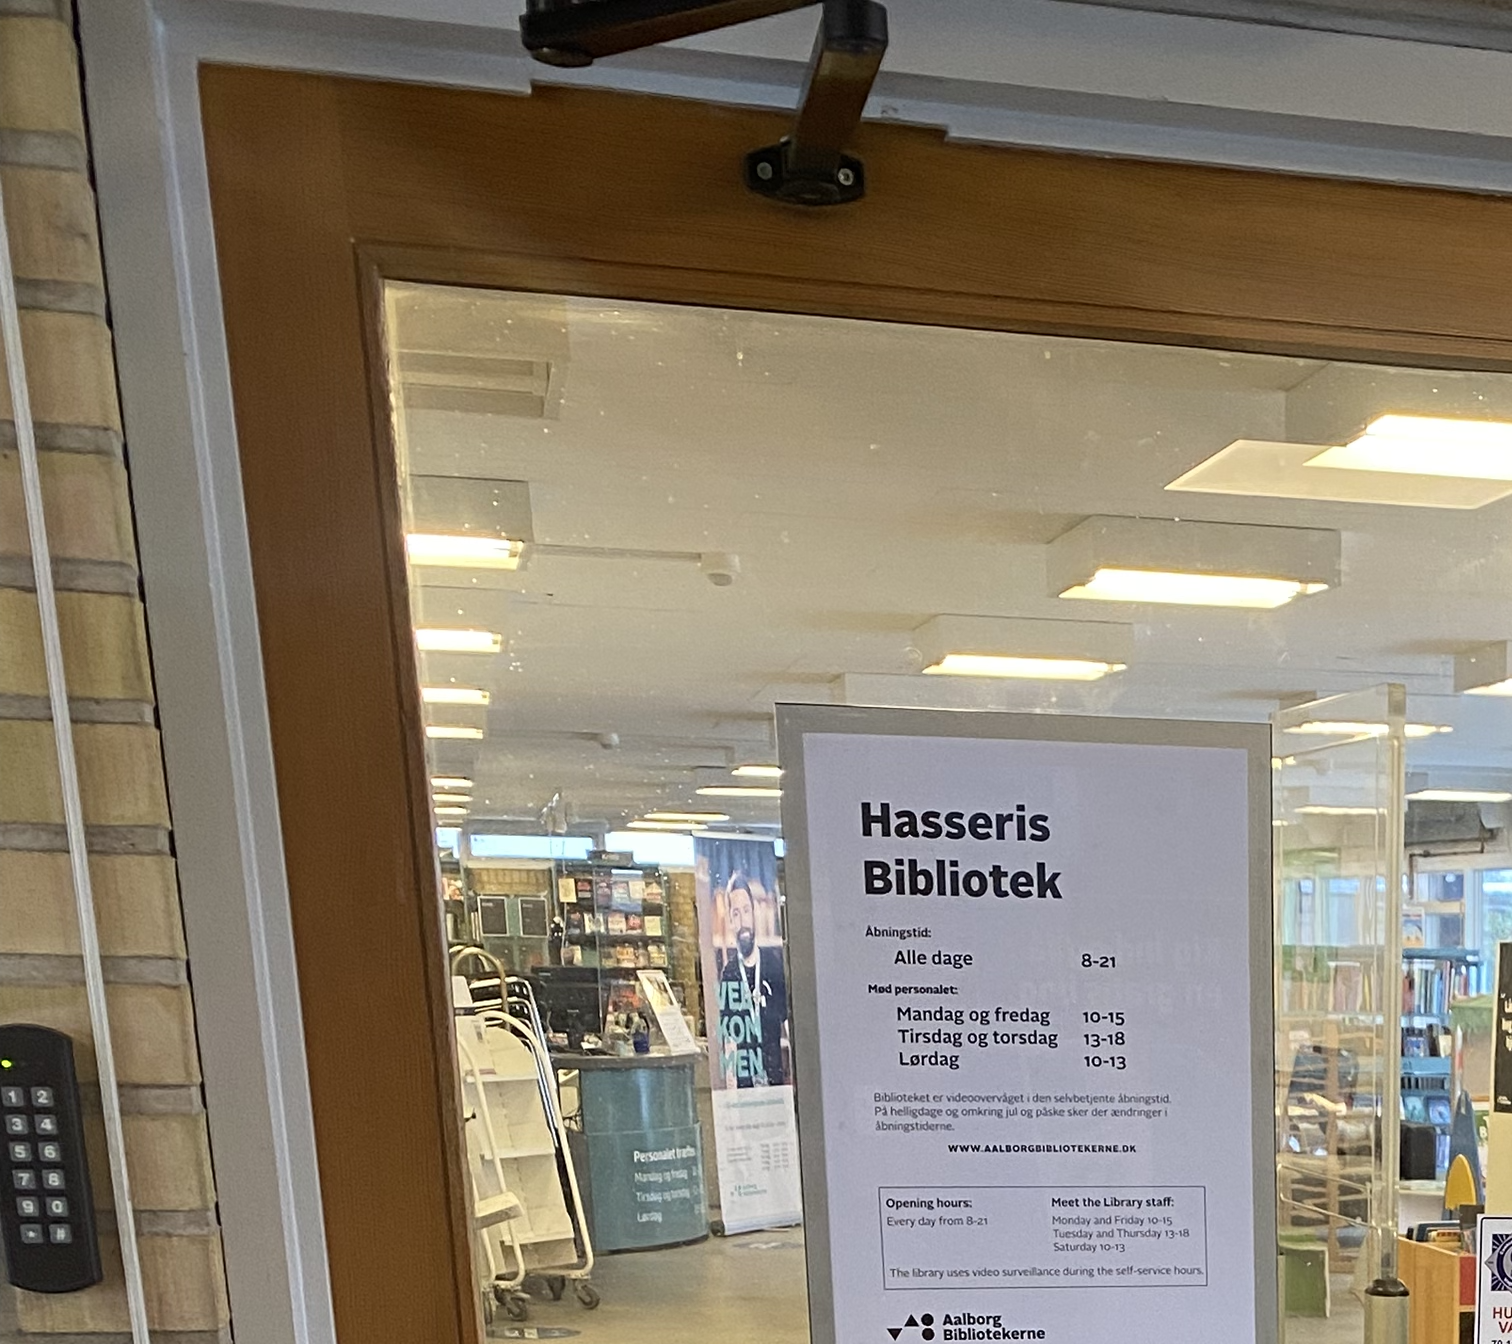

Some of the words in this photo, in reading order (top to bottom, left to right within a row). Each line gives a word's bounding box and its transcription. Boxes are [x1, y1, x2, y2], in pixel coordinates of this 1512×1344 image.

[861, 802, 1050, 842] Hasseris
[864, 858, 1062, 899] Bibliotek
[865, 925, 932, 940] Åbningstid:
[894, 950, 927, 965] Alle
[932, 951, 973, 969] dage
[1081, 953, 1116, 968] 8-21
[868, 984, 892, 995] Mød
[895, 984, 959, 996] personalet:
[897, 1006, 964, 1024] Mandag
[969, 1010, 990, 1026] og
[994, 1007, 1051, 1026] fredag
[1082, 1011, 1125, 1026] 10-15
[898, 1028, 962, 1047] Tirsdag
[967, 1032, 988, 1047] og
[993, 1030, 1058, 1048] torsdag
[1084, 1031, 1125, 1047] 13-18
[899, 1051, 960, 1069] Lørdag
[1084, 1054, 1127, 1070] 10-13
[8, 1090, 17, 1104] 1
[36, 1090, 48, 1104] 2
[874, 1092, 930, 1103] Biblioteket
[932, 1094, 943, 1103] er
[946, 1093, 1024, 1105] videoovervåget
[1032, 1093, 1051, 1103] den
[1054, 1093, 1115, 1106] selvbetjente
[1118, 1094, 1172, 1106] åbningstid.
[874, 1106, 888, 1116] På
[890, 1106, 943, 1118] helligdage
[946, 1108, 959, 1119] og
[961, 1106, 1003, 1119] omkring
[1005, 1106, 1017, 1119] jul
[1020, 1108, 1033, 1119] og
[1036, 1106, 1065, 1118] påske
[1068, 1106, 1088, 1117] sker
[1091, 1107, 1108, 1117] der
[1110, 1107, 1162, 1119] ændringer
[12, 1118, 23, 1131] 3
[40, 1118, 53, 1131] 4
[875, 1120, 955, 1133] åbningstiderne.
[15, 1145, 26, 1158] 5
[44, 1146, 56, 1159] 6
[948, 1144, 1137, 1153] WWW.AALBORGBIBLIOTEKERNE.DK
[18, 1173, 30, 1186] 7
[48, 1173, 59, 1186] 8
[22, 1201, 34, 1213] 9
[52, 1201, 63, 1213] 0
[886, 1198, 935, 1210] Opening
[936, 1198, 972, 1209] hours:
[1052, 1198, 1079, 1208] Meet
[1082, 1197, 1101, 1207] the
[1104, 1197, 1143, 1210] Library
[1146, 1197, 1174, 1207] staff:
[887, 1216, 915, 1228] Every
[918, 1216, 936, 1228] day
[939, 1216, 964, 1226] from
[966, 1217, 988, 1226] 8-21
[1052, 1216, 1091, 1227] Monday
[1094, 1216, 1112, 1226] and
[1114, 1216, 1145, 1227] Friday
[1148, 1216, 1173, 1226] 10-15
[1054, 1228, 1093, 1240] Tuesday
[1096, 1228, 1114, 1239] and
[1116, 1228, 1162, 1240] Thursday
[1165, 1228, 1190, 1239] 13-18
[1054, 1242, 1097, 1253] Saturday
[1100, 1243, 1126, 1253] 10-13
[890, 1268, 910, 1278] The
[912, 1268, 944, 1280] library
[947, 1269, 969, 1278] uses
[972, 1267, 1000, 1278] video
[1002, 1267, 1060, 1277] surveillance
[1063, 1266, 1095, 1279] during
[1097, 1266, 1114, 1277] the
[1116, 1266, 1171, 1277] self-service
[1174, 1266, 1204, 1276] hours.
[943, 1312, 1003, 1329] Aalborg
[943, 1327, 1046, 1341] Bibliotekerne
